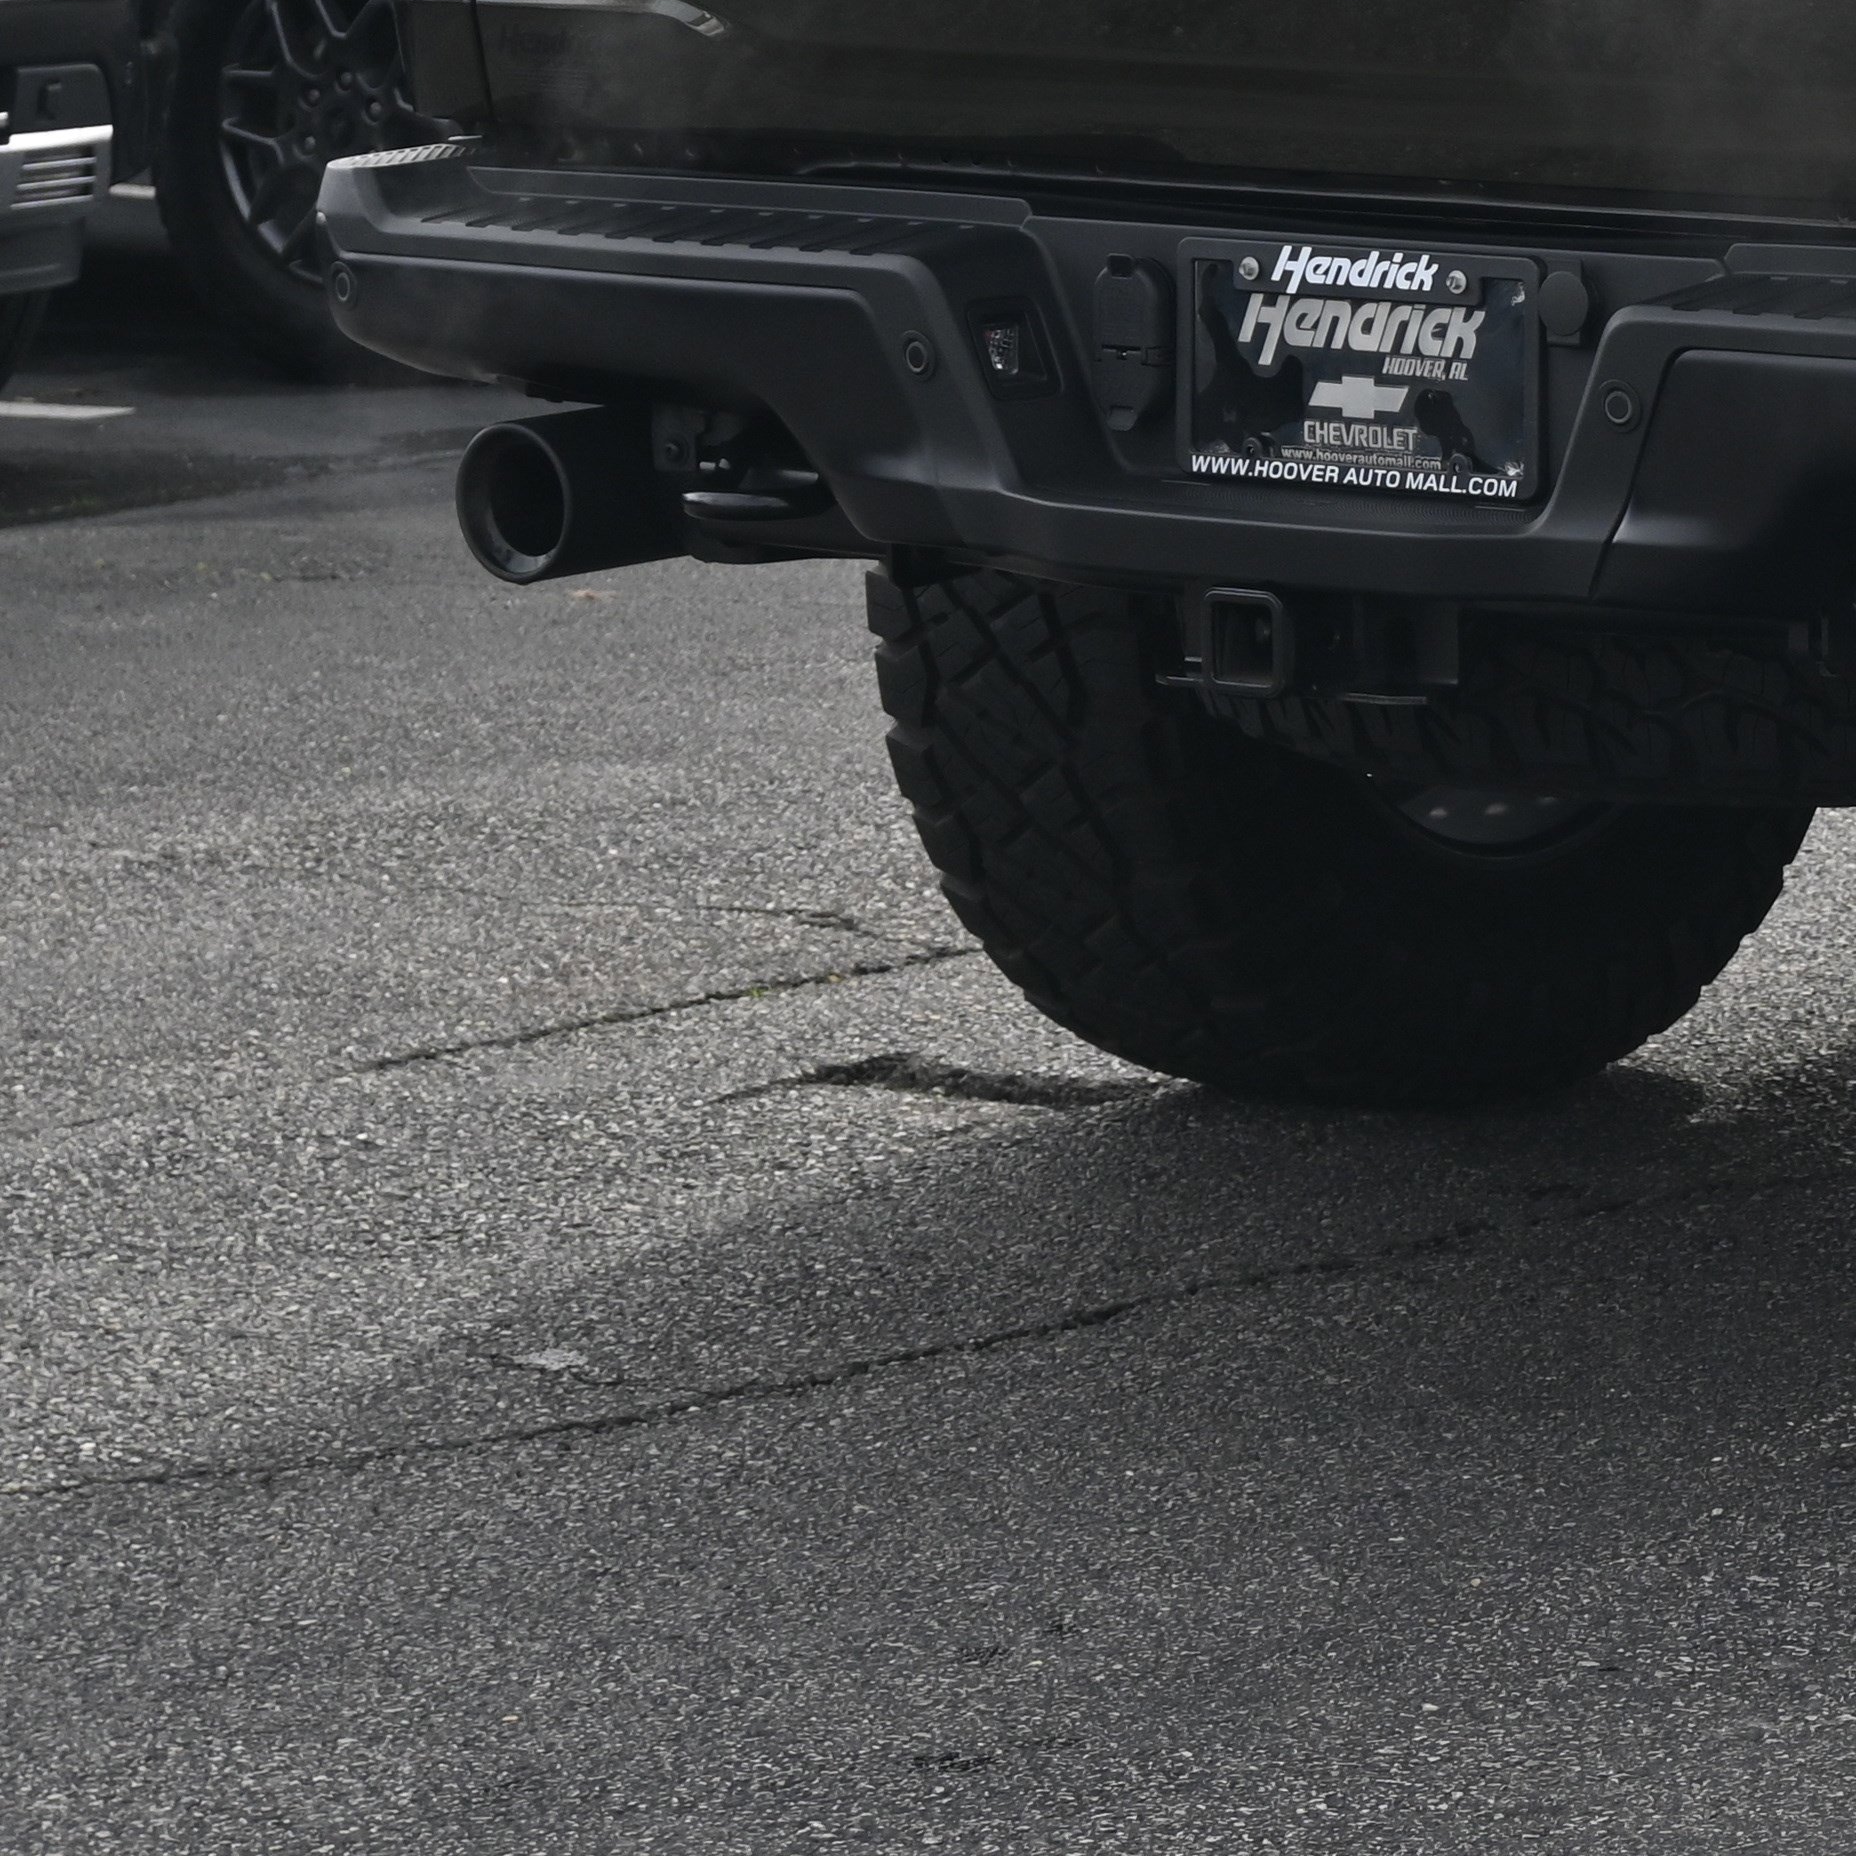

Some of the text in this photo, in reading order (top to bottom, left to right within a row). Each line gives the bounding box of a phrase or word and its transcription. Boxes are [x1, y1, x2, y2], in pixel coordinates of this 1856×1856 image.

[1271, 245, 1439, 294] Hendrick
[1238, 293, 1486, 366] Hendrick
[1382, 355, 1469, 381] HOOVER, AL
[1303, 420, 1418, 451] CHEVROLET
[1191, 454, 1518, 498] WWW.HOOVER AUTO MALL.COM
[1281, 446, 1442, 471] www.hooverautomall.com
